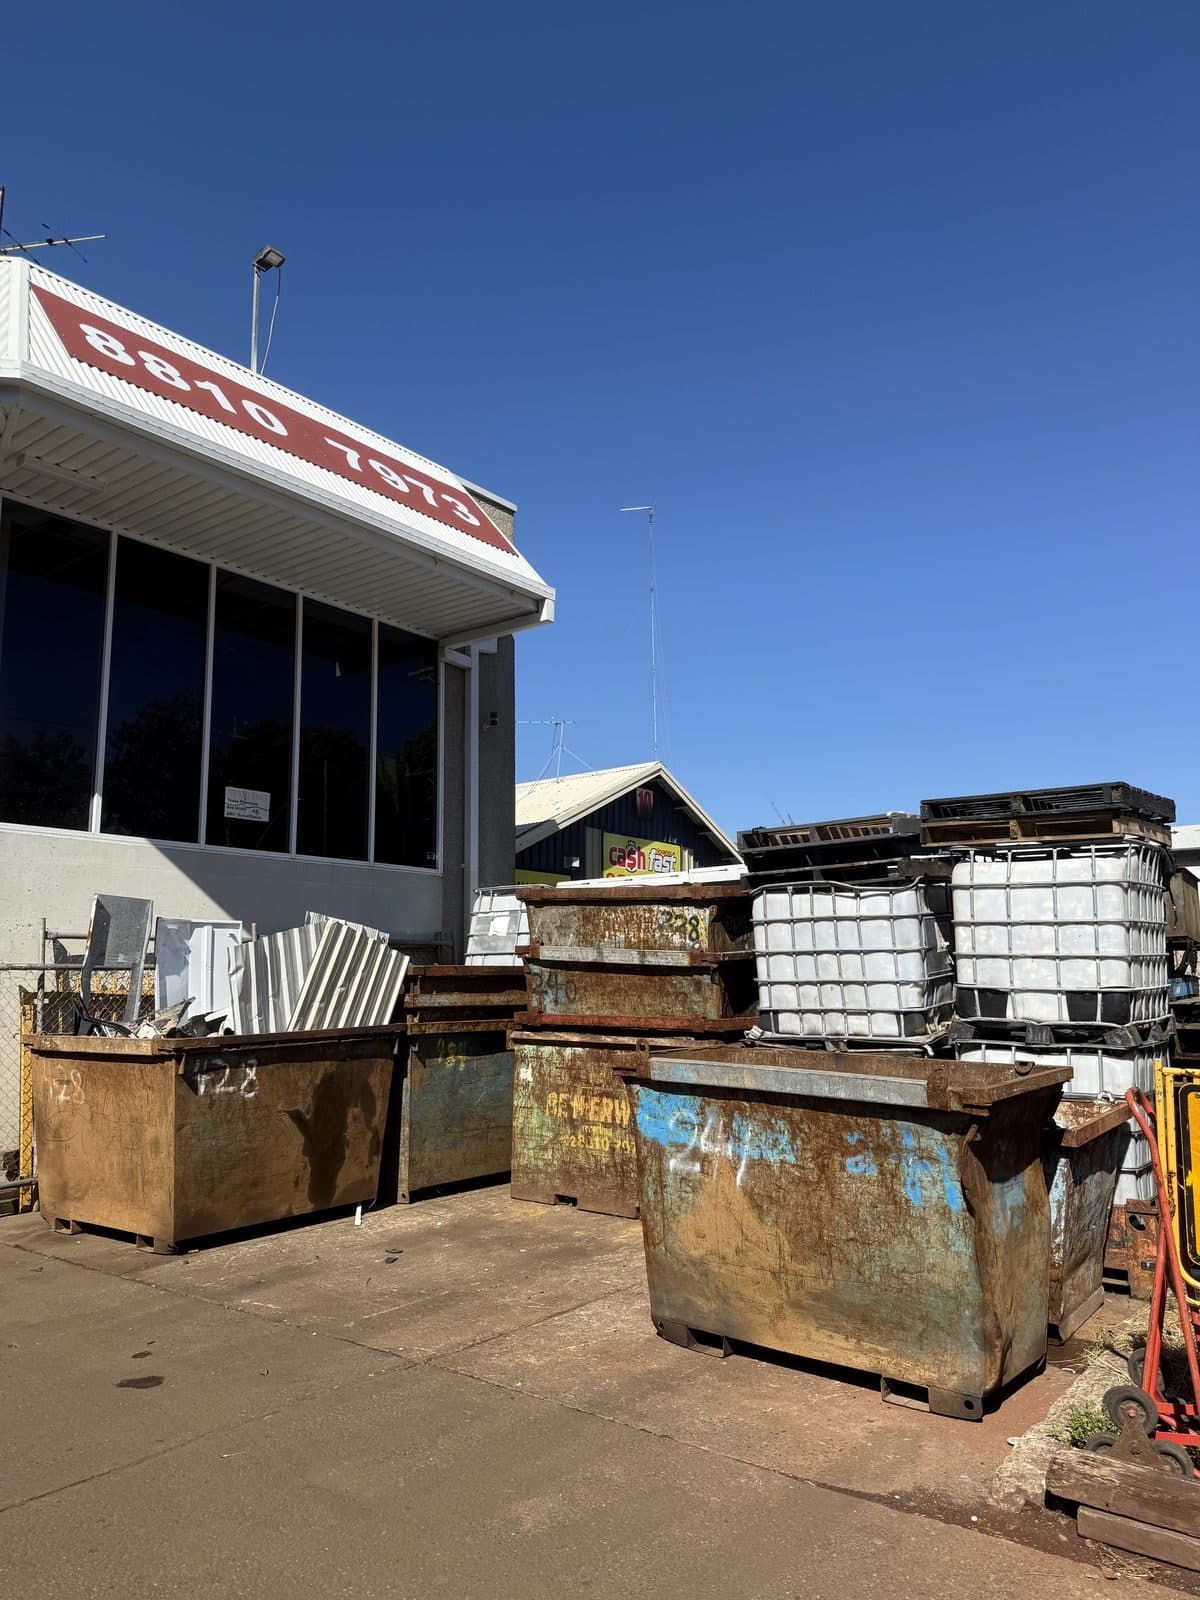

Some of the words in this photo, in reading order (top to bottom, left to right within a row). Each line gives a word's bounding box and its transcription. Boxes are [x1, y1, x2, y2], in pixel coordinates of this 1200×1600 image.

[79, 323, 289, 437] 8810
[324, 437, 481, 527] 7973
[648, 848, 677, 873] fast
